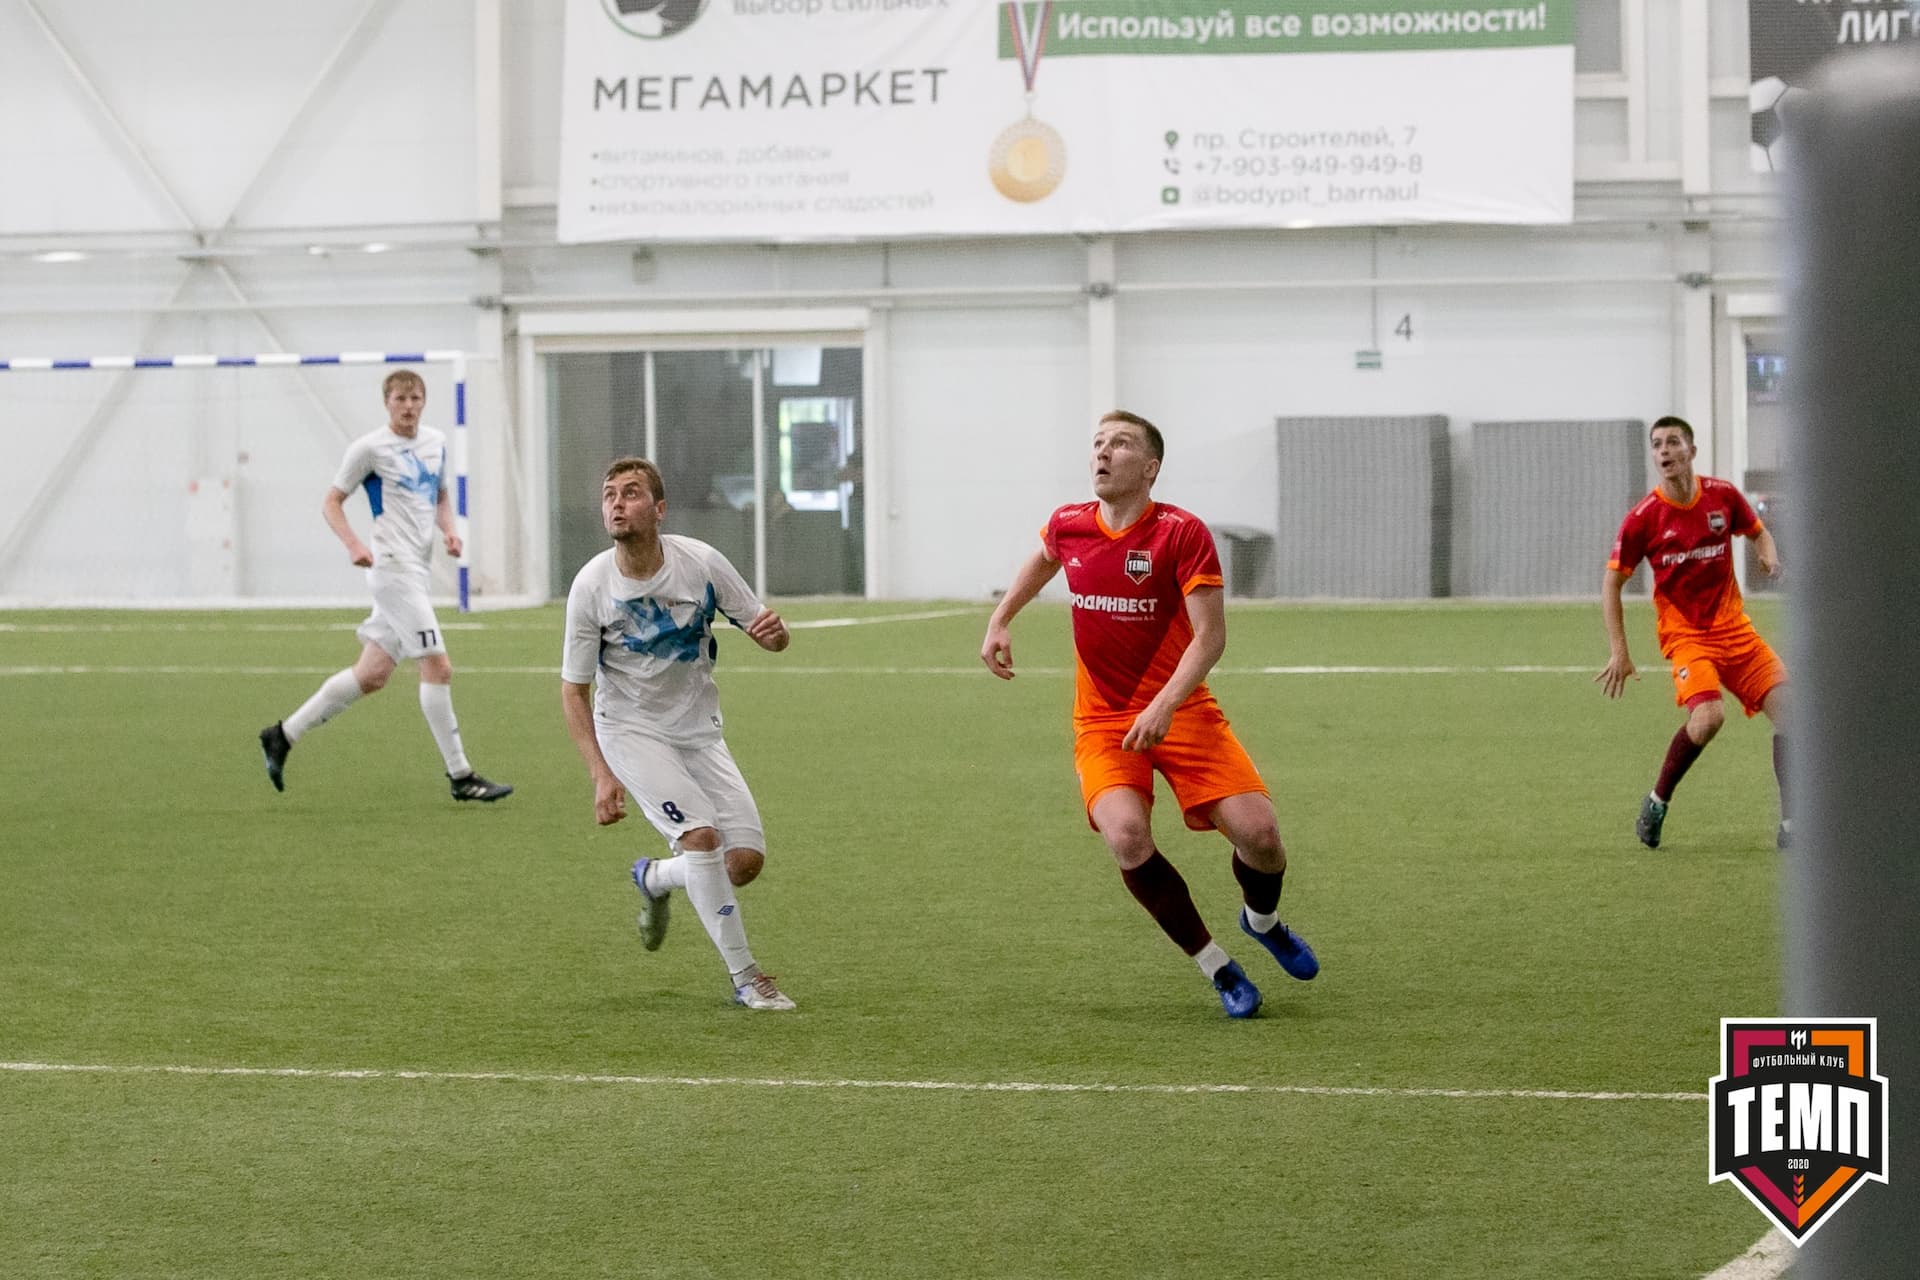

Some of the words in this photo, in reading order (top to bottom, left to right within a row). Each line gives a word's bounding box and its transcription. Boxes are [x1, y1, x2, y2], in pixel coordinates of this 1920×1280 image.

[1057, 9, 1234, 44] Используй
[1245, 14, 1302, 38] все
[1311, 2, 1547, 37] возможности!
[593, 68, 948, 111] МЕГАМАРКЕТ
[1193, 132, 1230, 151] пр.
[1238, 126, 1395, 150] Строителей,
[1403, 125, 1418, 145] 7
[1194, 153, 1424, 176] +7-903-949-949-8
[1394, 313, 1414, 341] 4
[1128, 559, 1149, 572] ТЕМП
[662, 801, 685, 823] 8
